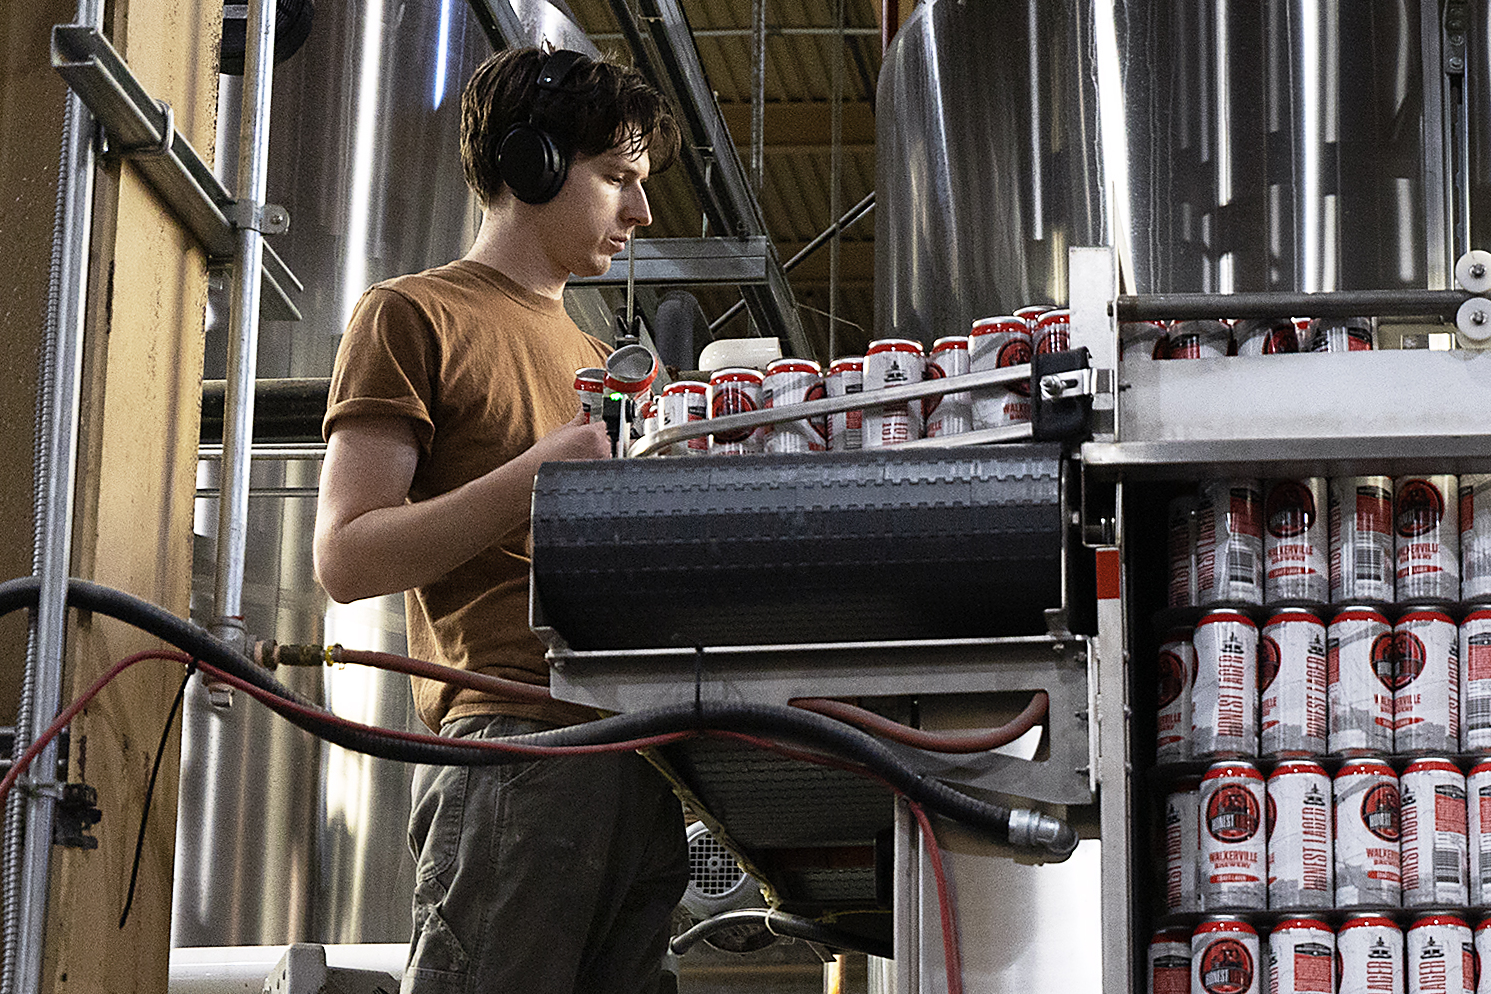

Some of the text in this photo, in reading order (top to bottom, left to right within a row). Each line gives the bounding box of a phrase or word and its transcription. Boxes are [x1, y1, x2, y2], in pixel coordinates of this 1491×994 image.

[1210, 852, 1258, 863] WALKERVILLE
[1302, 807, 1327, 891] HONEST LAGER
